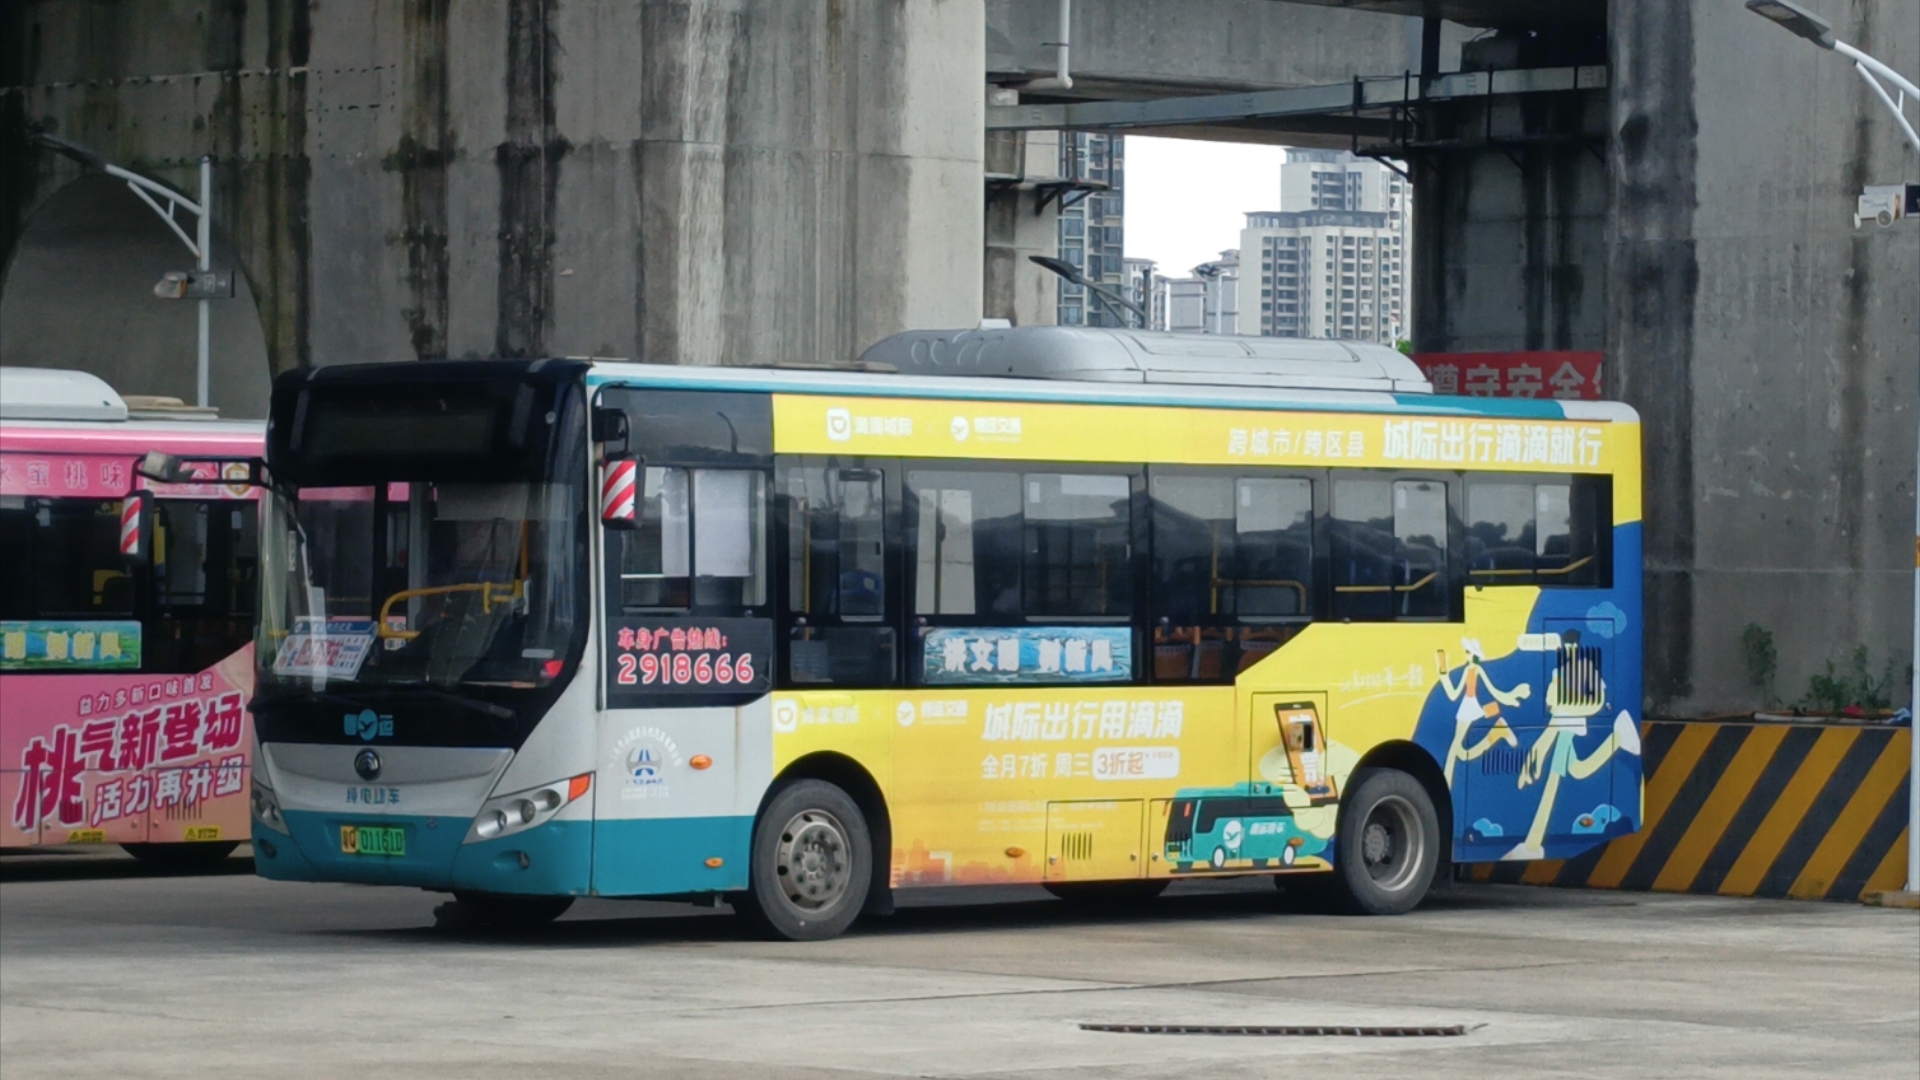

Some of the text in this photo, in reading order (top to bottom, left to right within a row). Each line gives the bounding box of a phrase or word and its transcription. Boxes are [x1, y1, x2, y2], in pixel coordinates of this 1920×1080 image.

[1425, 361, 1602, 398] 遵守安全
[1228, 420, 1602, 466] 跨城市/跨区县 城际出行滴滴就行
[617, 653, 755, 685] 2918666
[77, 672, 214, 716] 益力多新口味首发
[981, 700, 1184, 741] 城际出行用滴滴
[12, 689, 243, 833] 桃气新登场
[981, 750, 1145, 779] 全月7折 周三 3折起
[91, 754, 245, 828] 活力再升级
